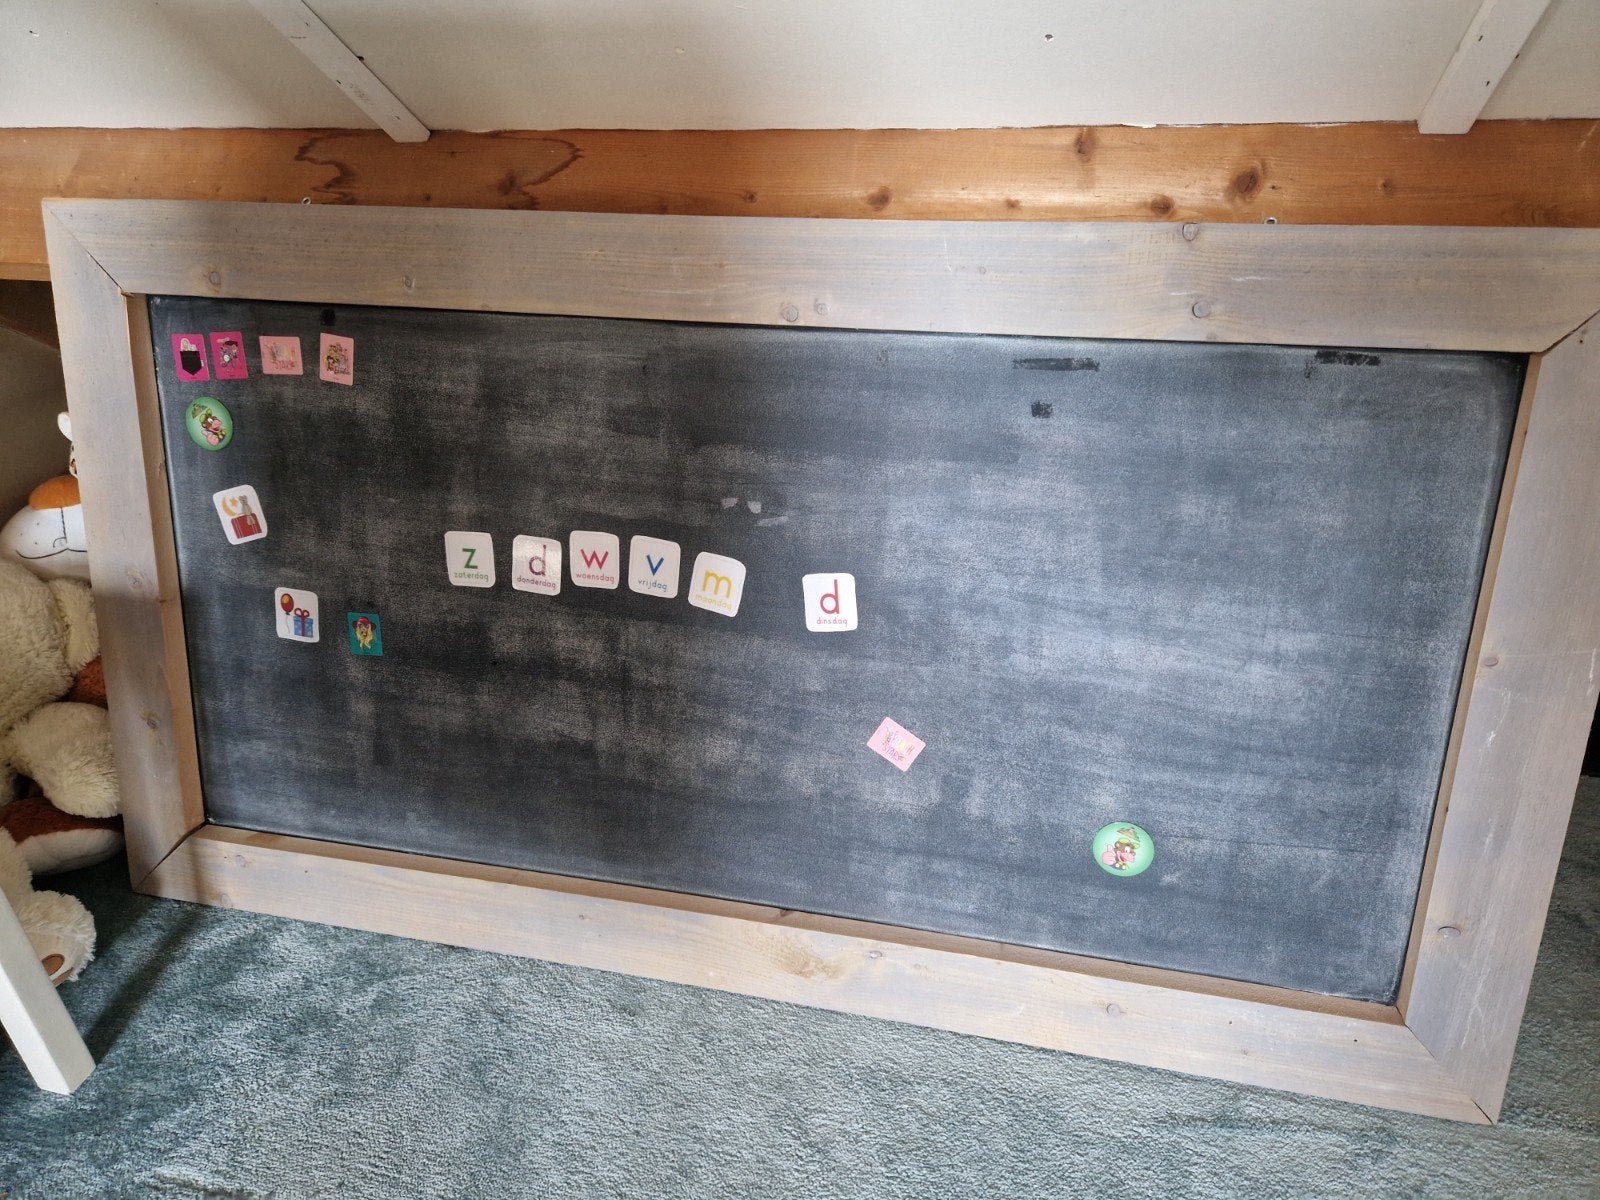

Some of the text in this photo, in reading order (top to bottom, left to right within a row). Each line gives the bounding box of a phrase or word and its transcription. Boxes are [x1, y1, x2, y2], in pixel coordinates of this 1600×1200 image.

[528, 544, 547, 577] d
[580, 548, 609, 570] w
[646, 554, 664, 576] v
[454, 570, 489, 582] zaterdag
[637, 578, 667, 592] vrijdag
[702, 570, 732, 599] m
[695, 593, 732, 612] maandag
[820, 579, 840, 615] d
[816, 616, 848, 627] dinsdag
